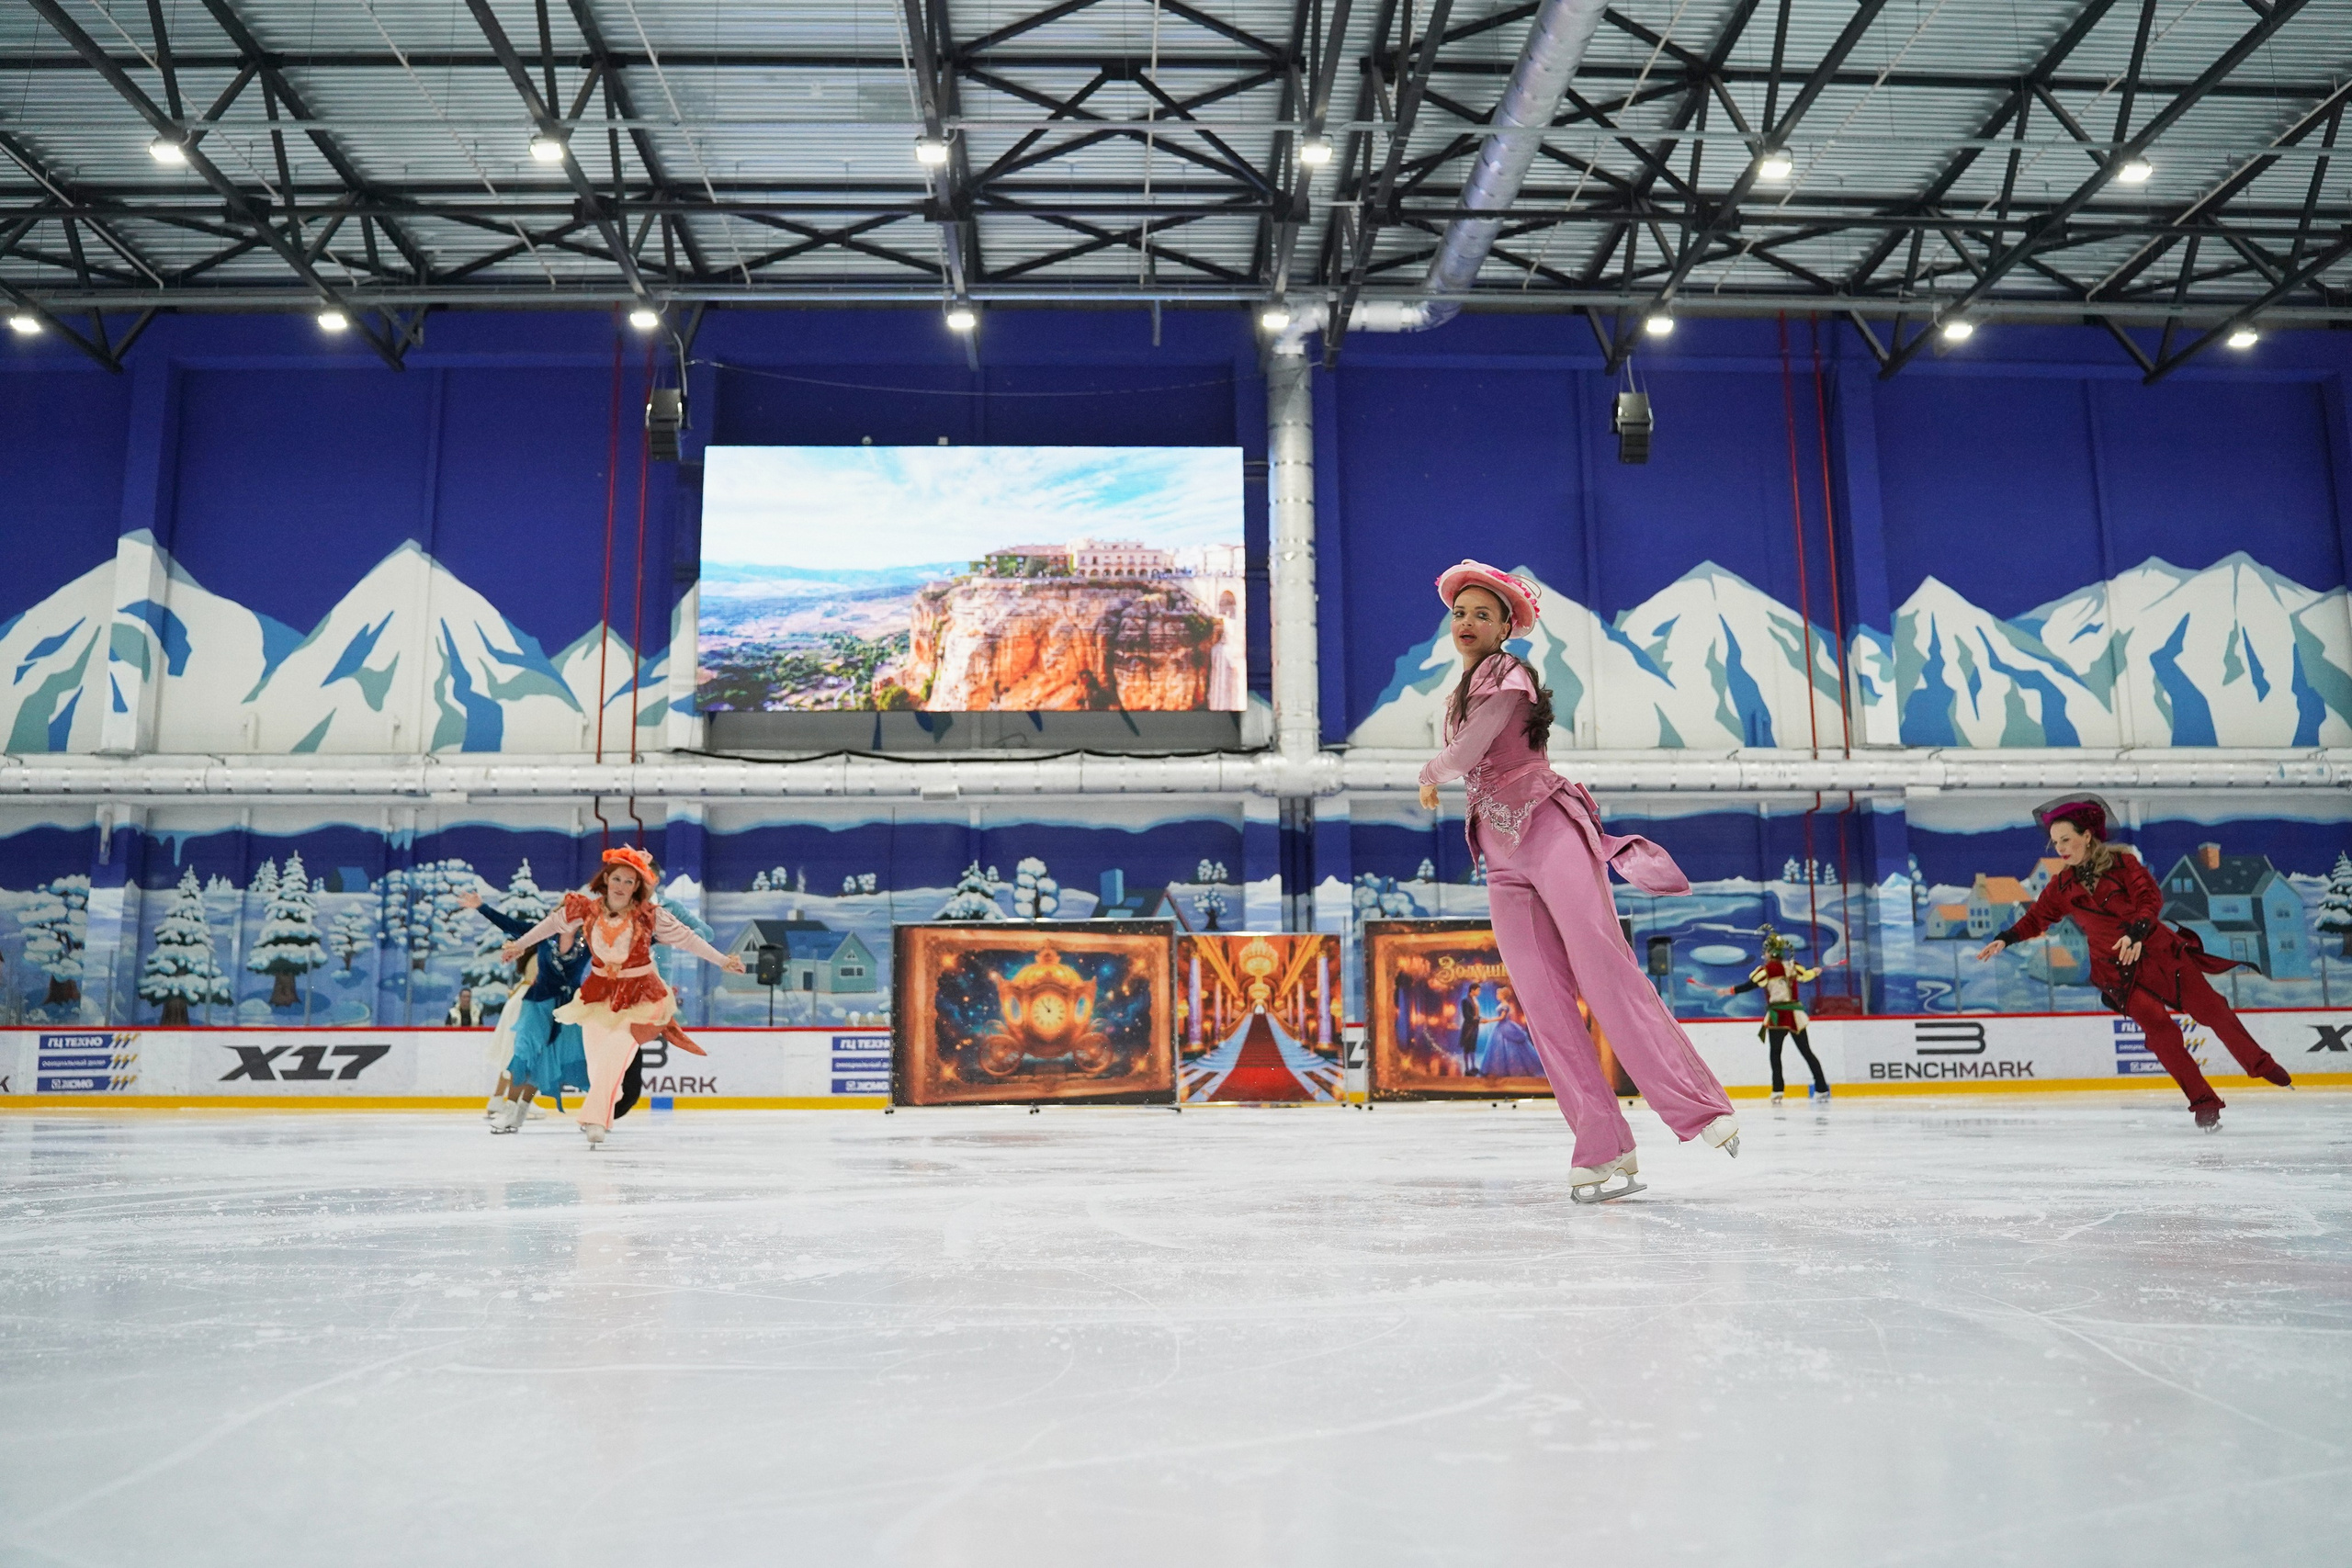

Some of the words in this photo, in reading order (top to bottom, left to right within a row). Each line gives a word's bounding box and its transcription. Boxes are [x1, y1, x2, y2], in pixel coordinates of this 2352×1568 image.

[1437, 955, 1508, 984] Золуш
[65, 1036, 103, 1047] ТЕХНО
[858, 1039, 889, 1049] ТЕХН
[218, 1044, 391, 1081] X17
[1870, 1060, 2035, 1079] BENCHMARK
